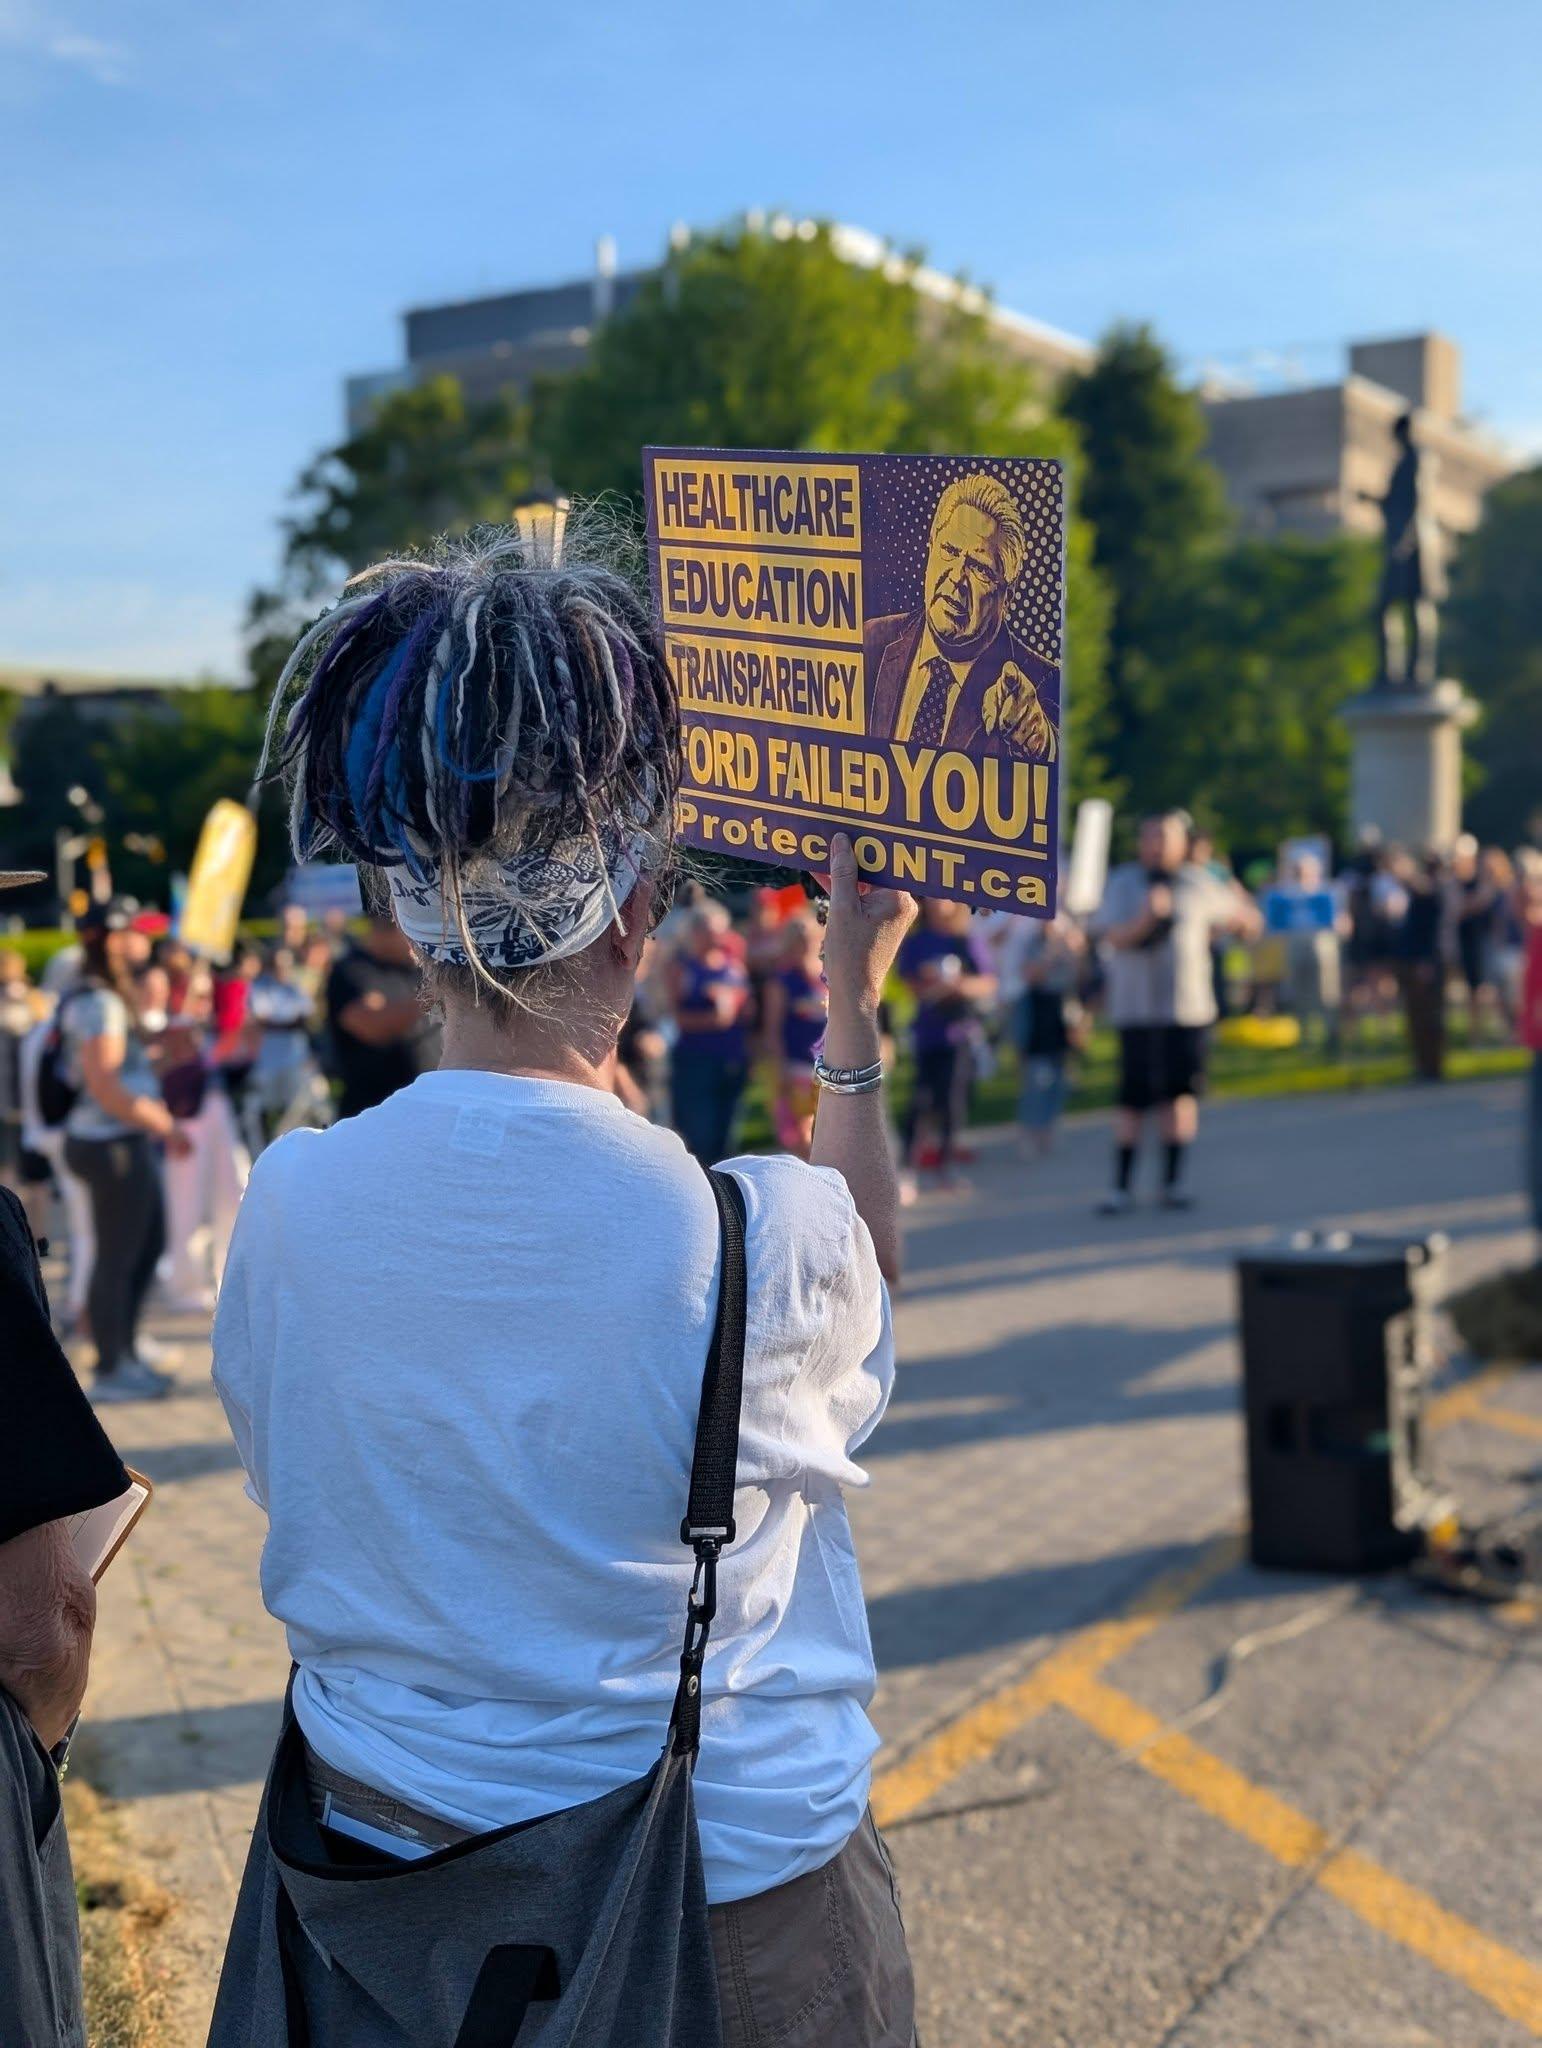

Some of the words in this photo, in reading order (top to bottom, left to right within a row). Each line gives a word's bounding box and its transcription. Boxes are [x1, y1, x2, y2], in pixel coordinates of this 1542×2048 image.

[660, 471, 855, 539] HEALTHCARE
[665, 558, 857, 630] EDUCATION
[670, 644, 857, 721] TRANSPARENCY
[768, 737, 890, 816] FAILED
[890, 744, 1049, 845] YOU!
[675, 801, 1048, 907] ProtecONT.ca
